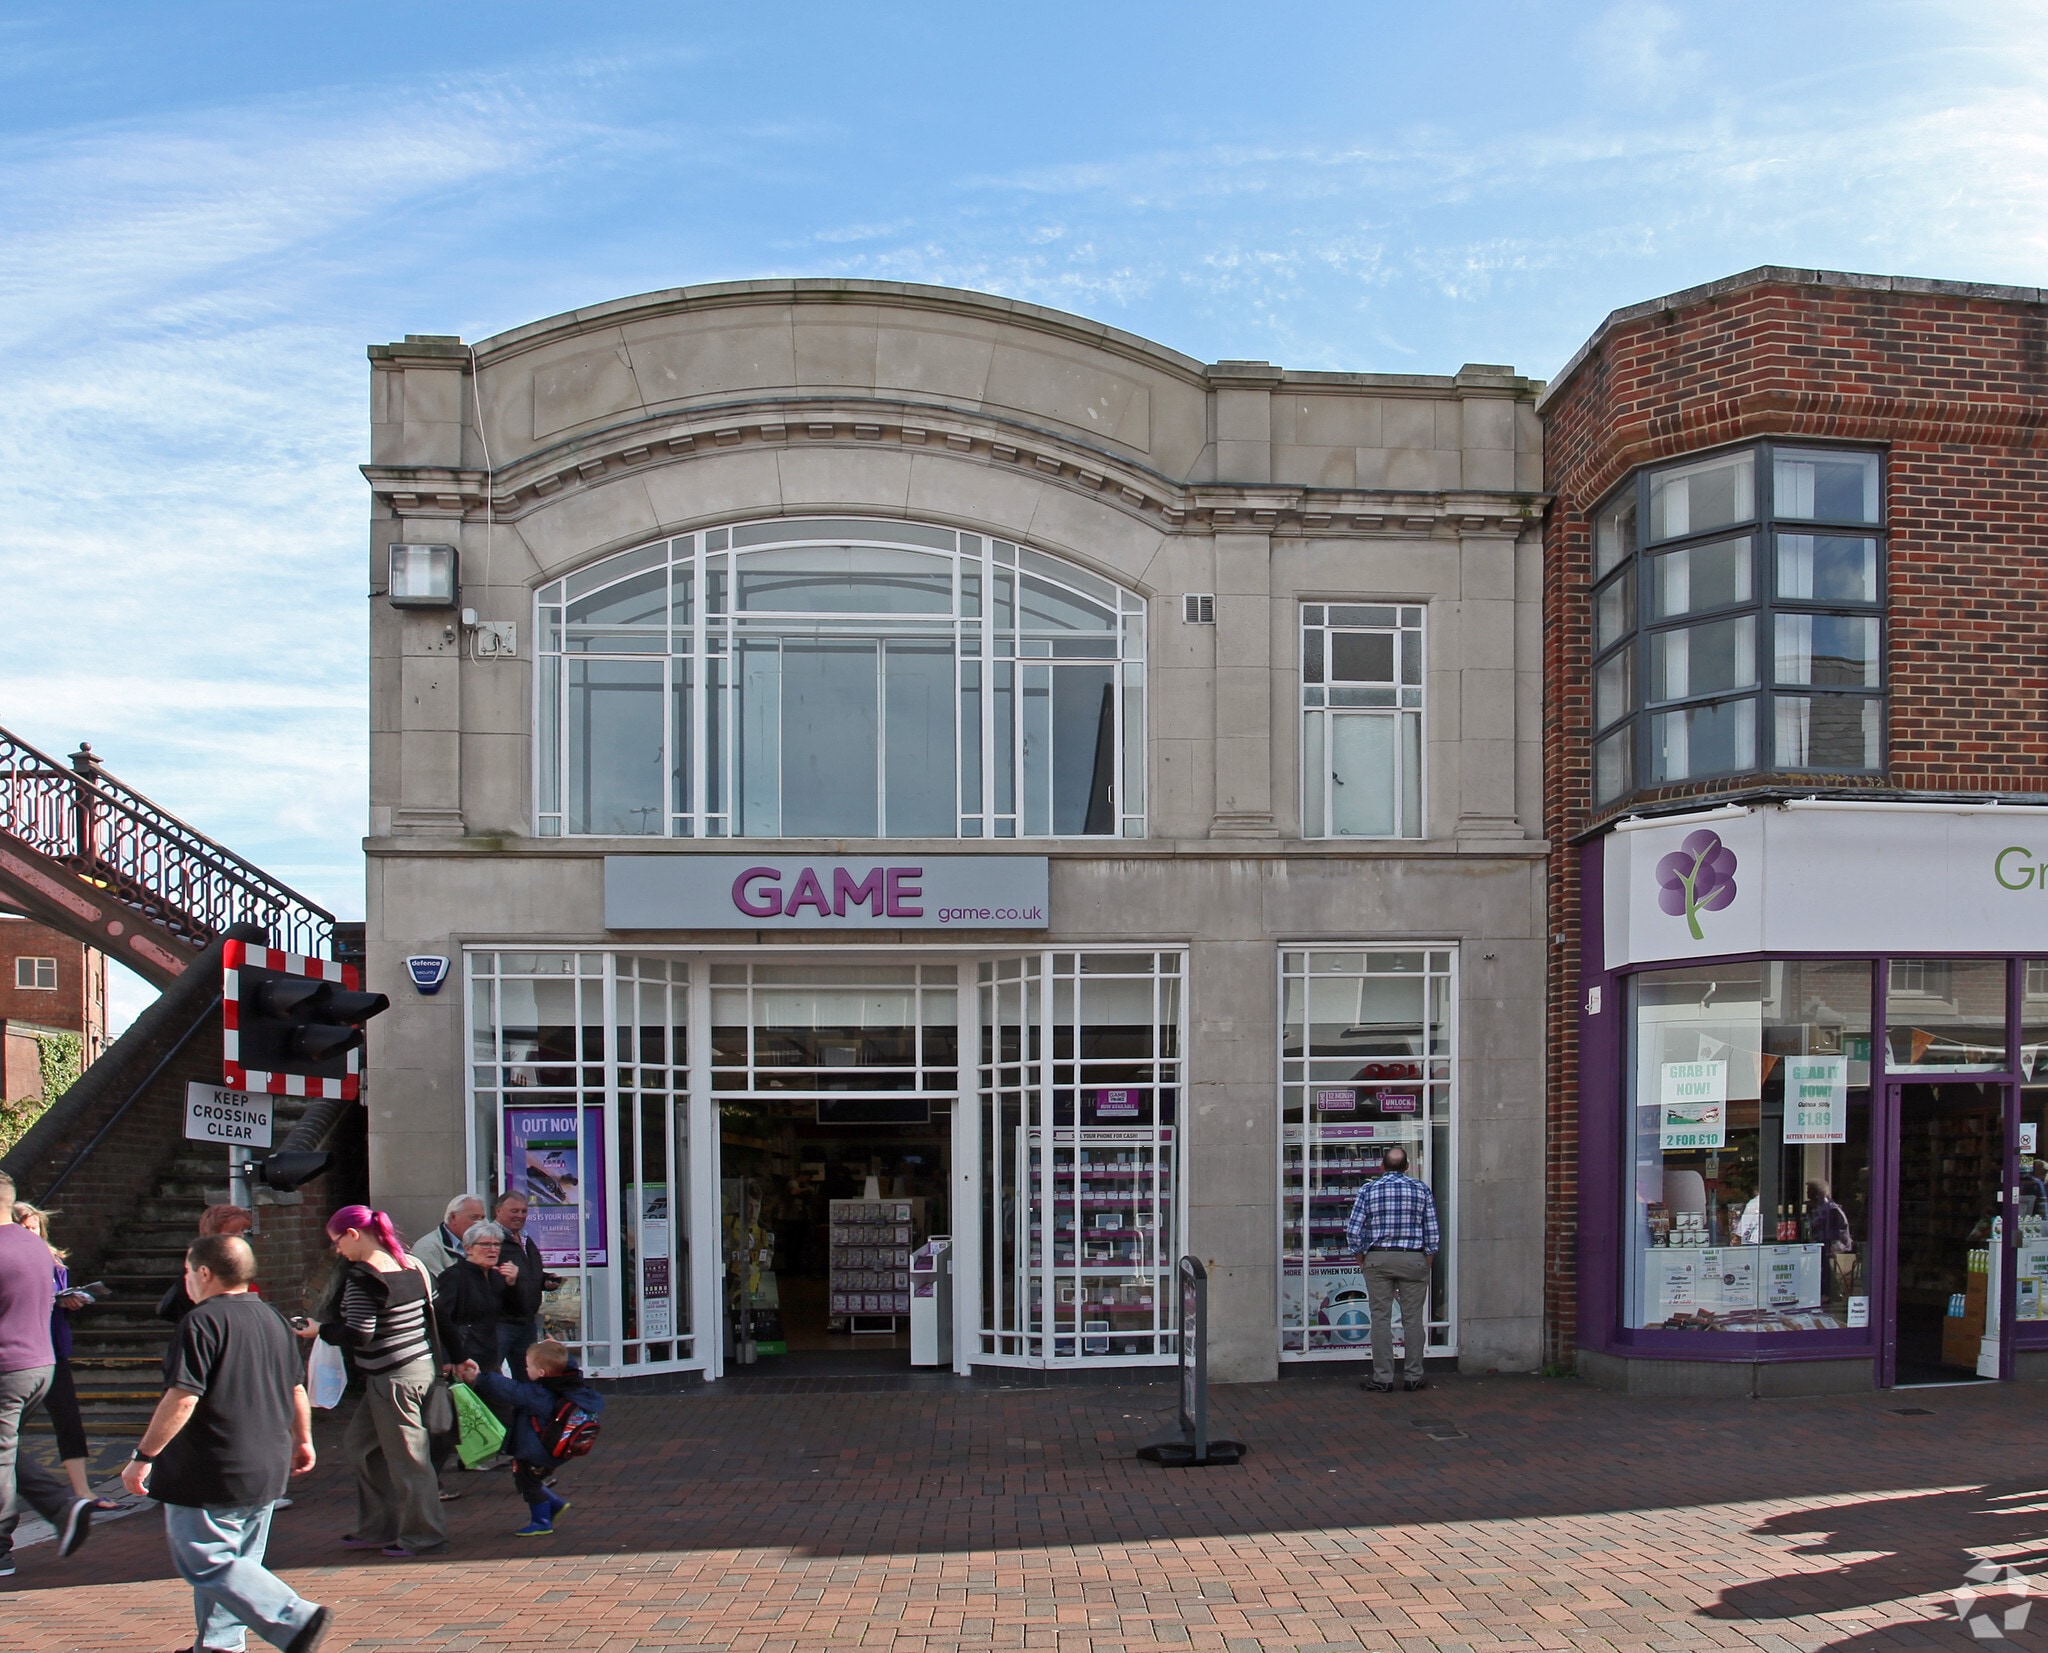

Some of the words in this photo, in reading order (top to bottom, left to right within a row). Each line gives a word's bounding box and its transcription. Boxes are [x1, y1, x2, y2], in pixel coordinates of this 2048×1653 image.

[732, 867, 924, 917] GAME
[938, 906, 1042, 923] game.co.uk
[1670, 1065, 1703, 1079] GRAB
[1706, 1064, 1718, 1077] IT
[1793, 1066, 1825, 1079] GRAB
[1676, 1082, 1711, 1096] NOW!
[1799, 1085, 1832, 1098] NOW!
[214, 1091, 249, 1107] KEEP
[193, 1104, 267, 1126] CROSSING
[1798, 1112, 1831, 1125] £1.89
[207, 1122, 252, 1139] CLEAR
[522, 1118, 548, 1133] OUT
[1667, 1135, 1673, 1145] 2
[1676, 1134, 1695, 1145] FOR
[1699, 1134, 1718, 1145] £10
